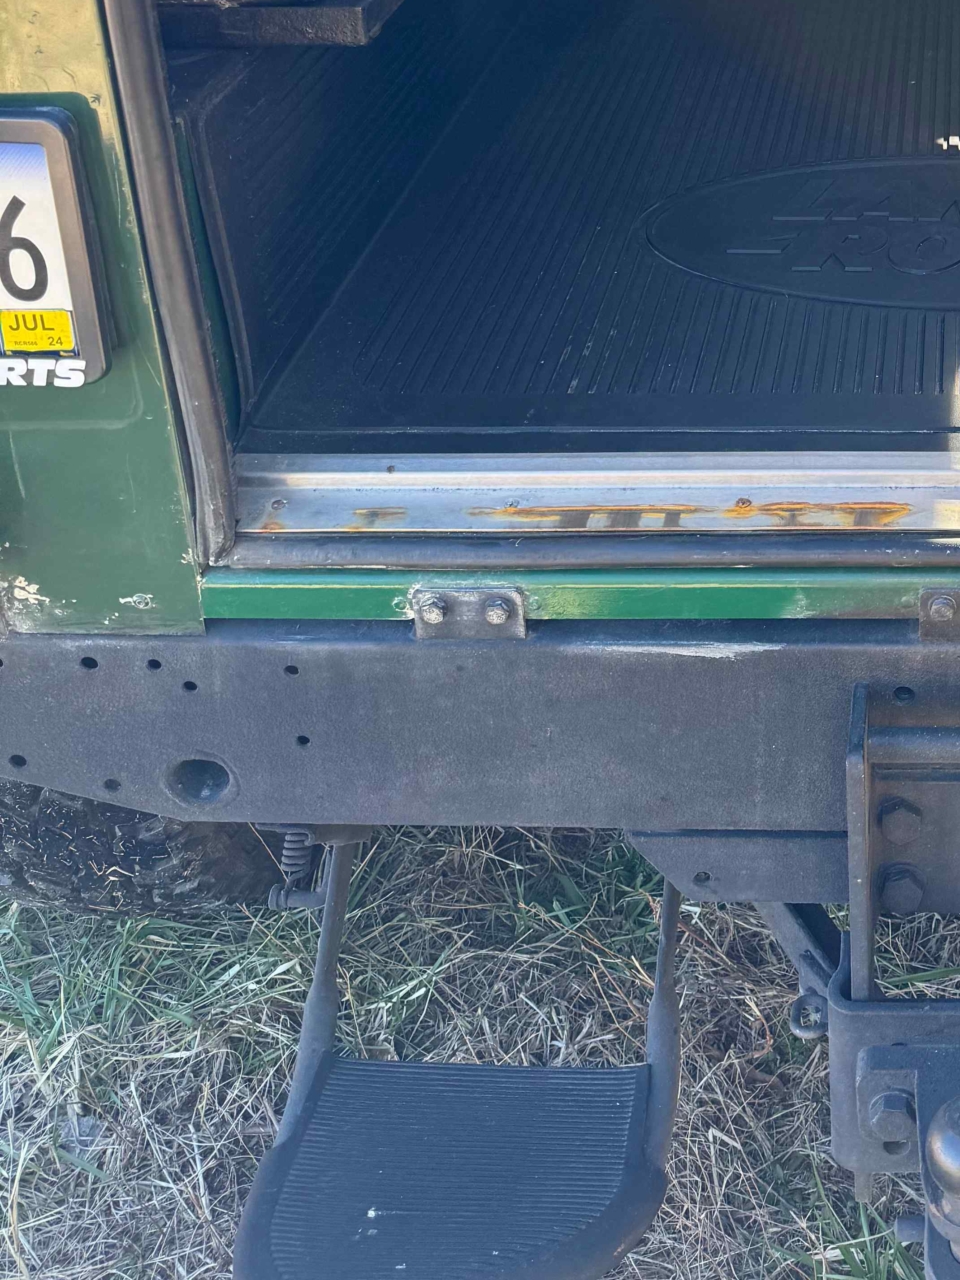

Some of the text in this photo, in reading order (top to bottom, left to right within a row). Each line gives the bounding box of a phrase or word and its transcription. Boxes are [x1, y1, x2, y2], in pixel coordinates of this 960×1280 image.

[0, 195, 48, 302] 6
[8, 314, 55, 331] JUL
[47, 336, 63, 346] 24
[0, 359, 86, 388] RTS
